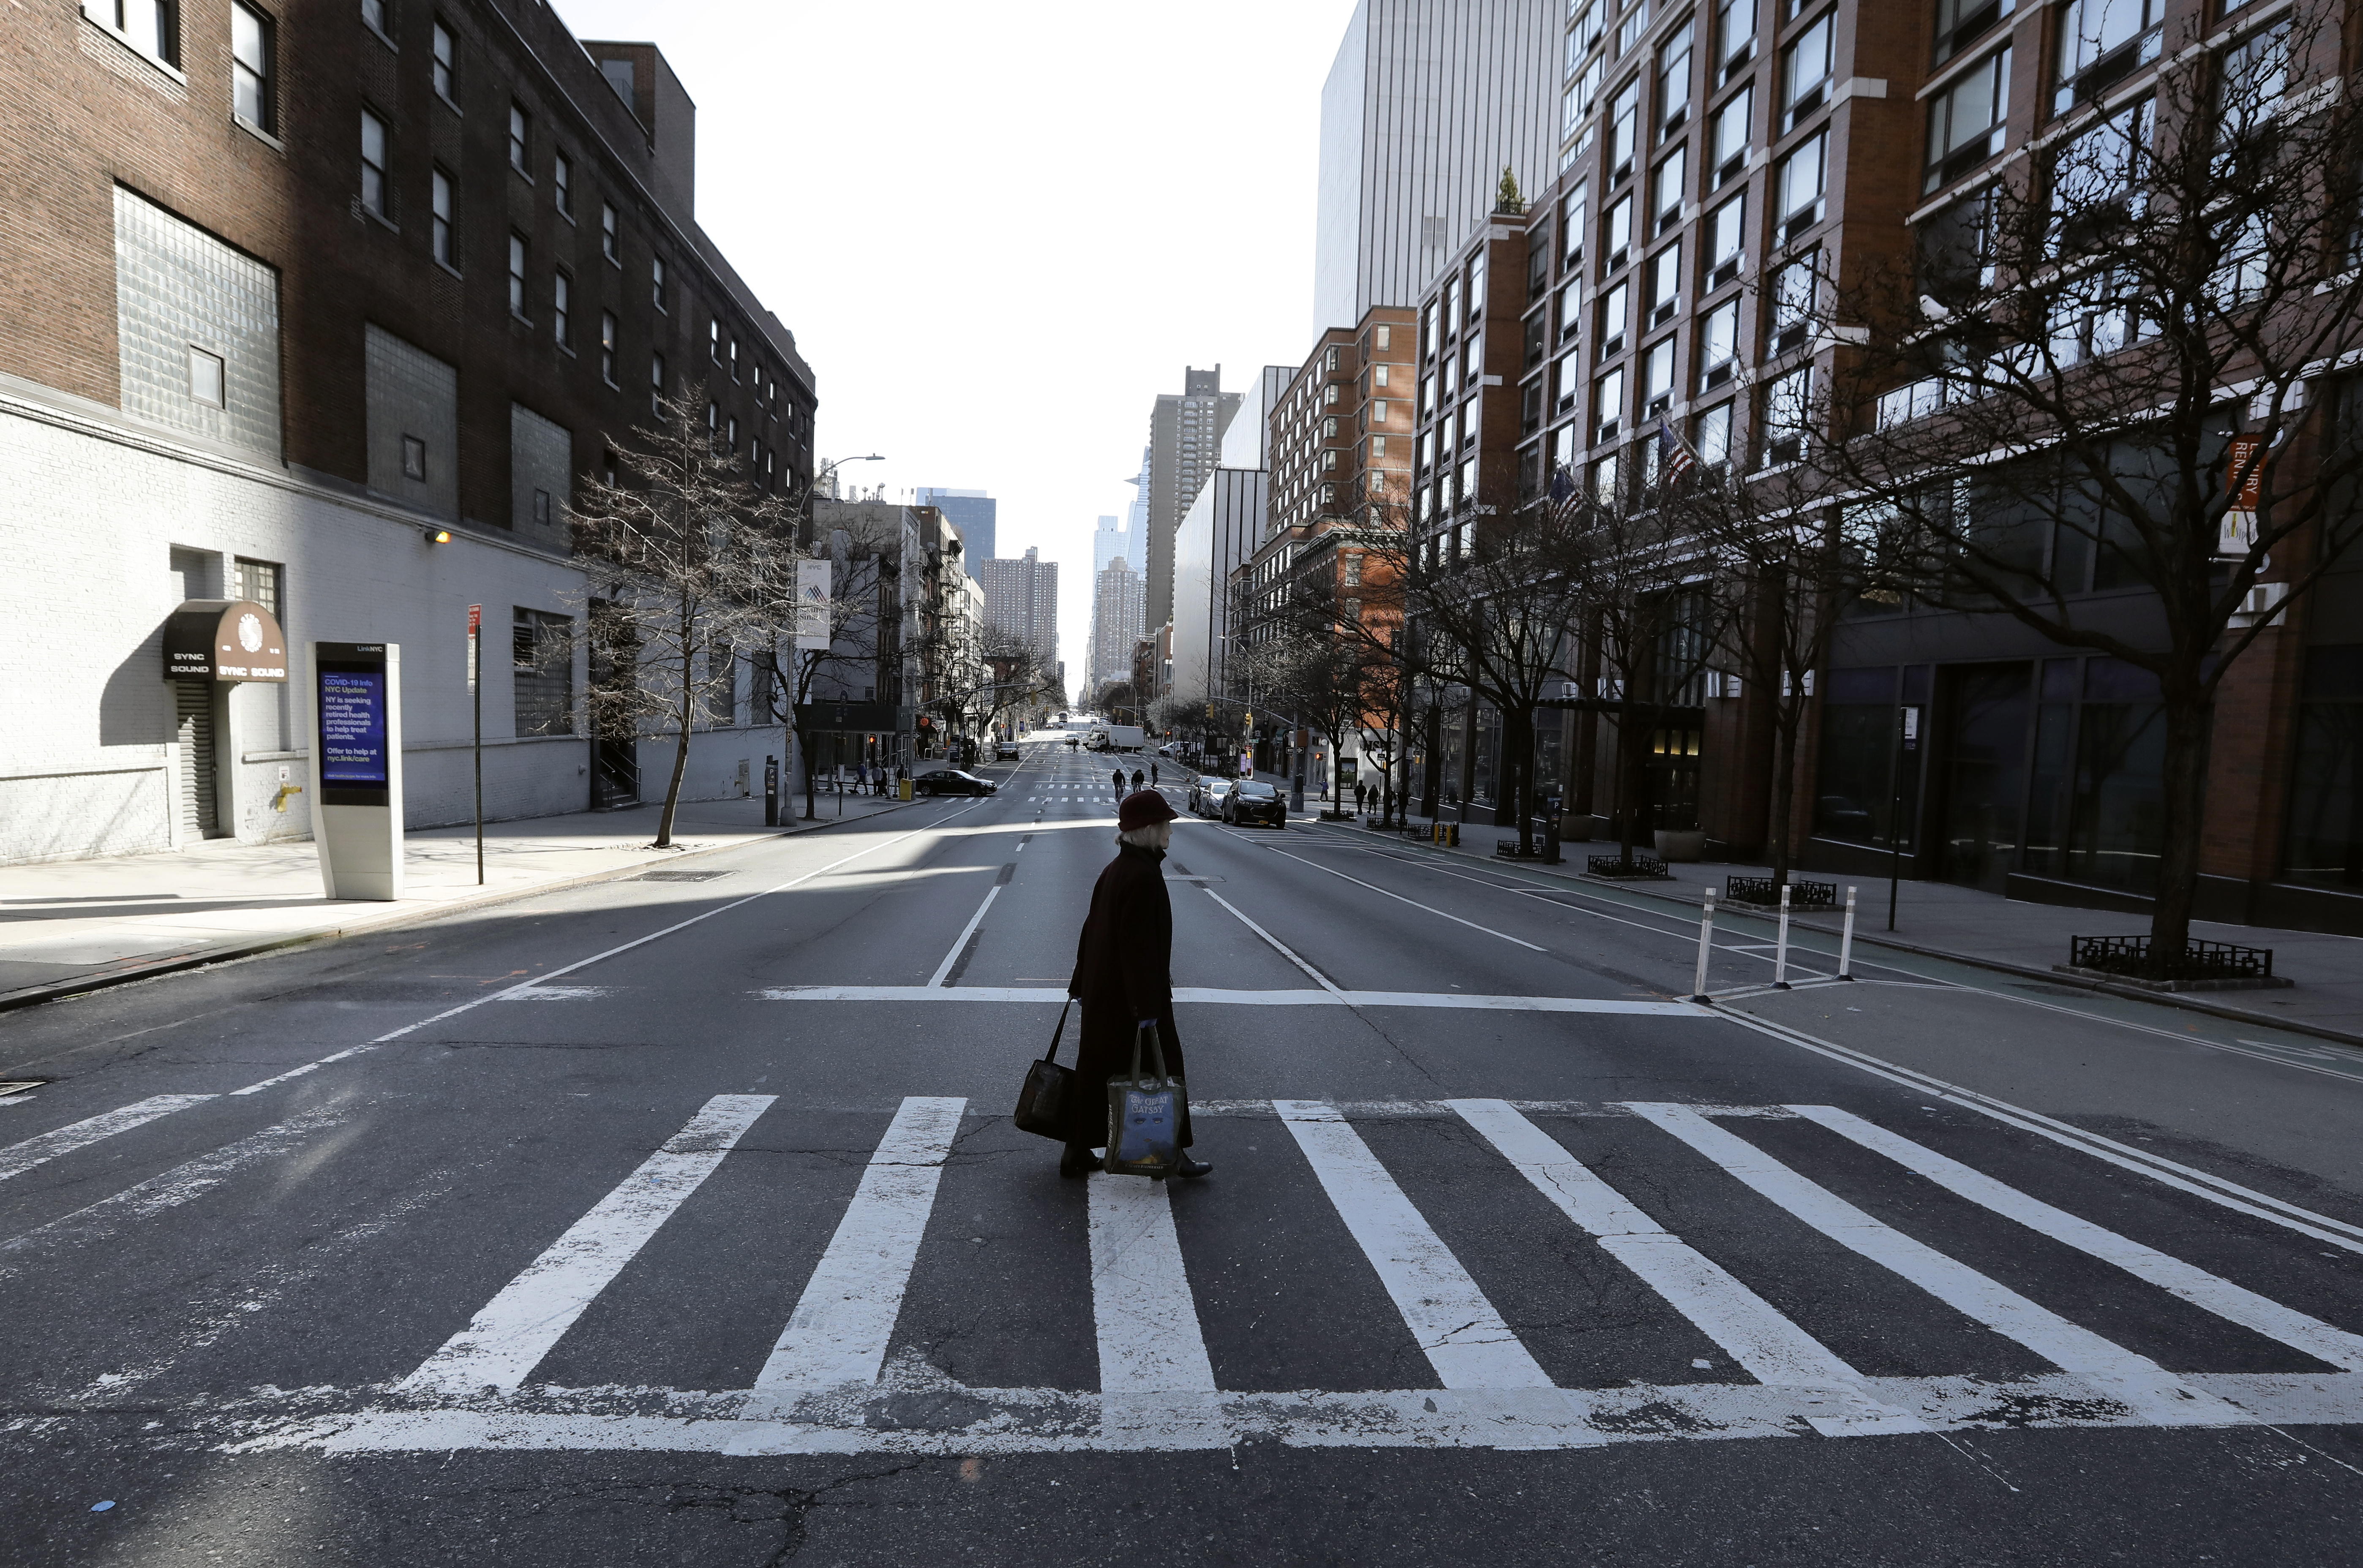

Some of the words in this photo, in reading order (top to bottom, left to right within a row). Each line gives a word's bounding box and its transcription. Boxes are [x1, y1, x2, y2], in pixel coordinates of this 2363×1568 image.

[219, 666, 247, 676] SYNC
[251, 668, 284, 677] SOUND
[1361, 741, 1396, 751] HSC
[1129, 1095, 1143, 1105] The
[1145, 1096, 1169, 1106] GREAT
[1132, 1104, 1164, 1114] GATSBY
